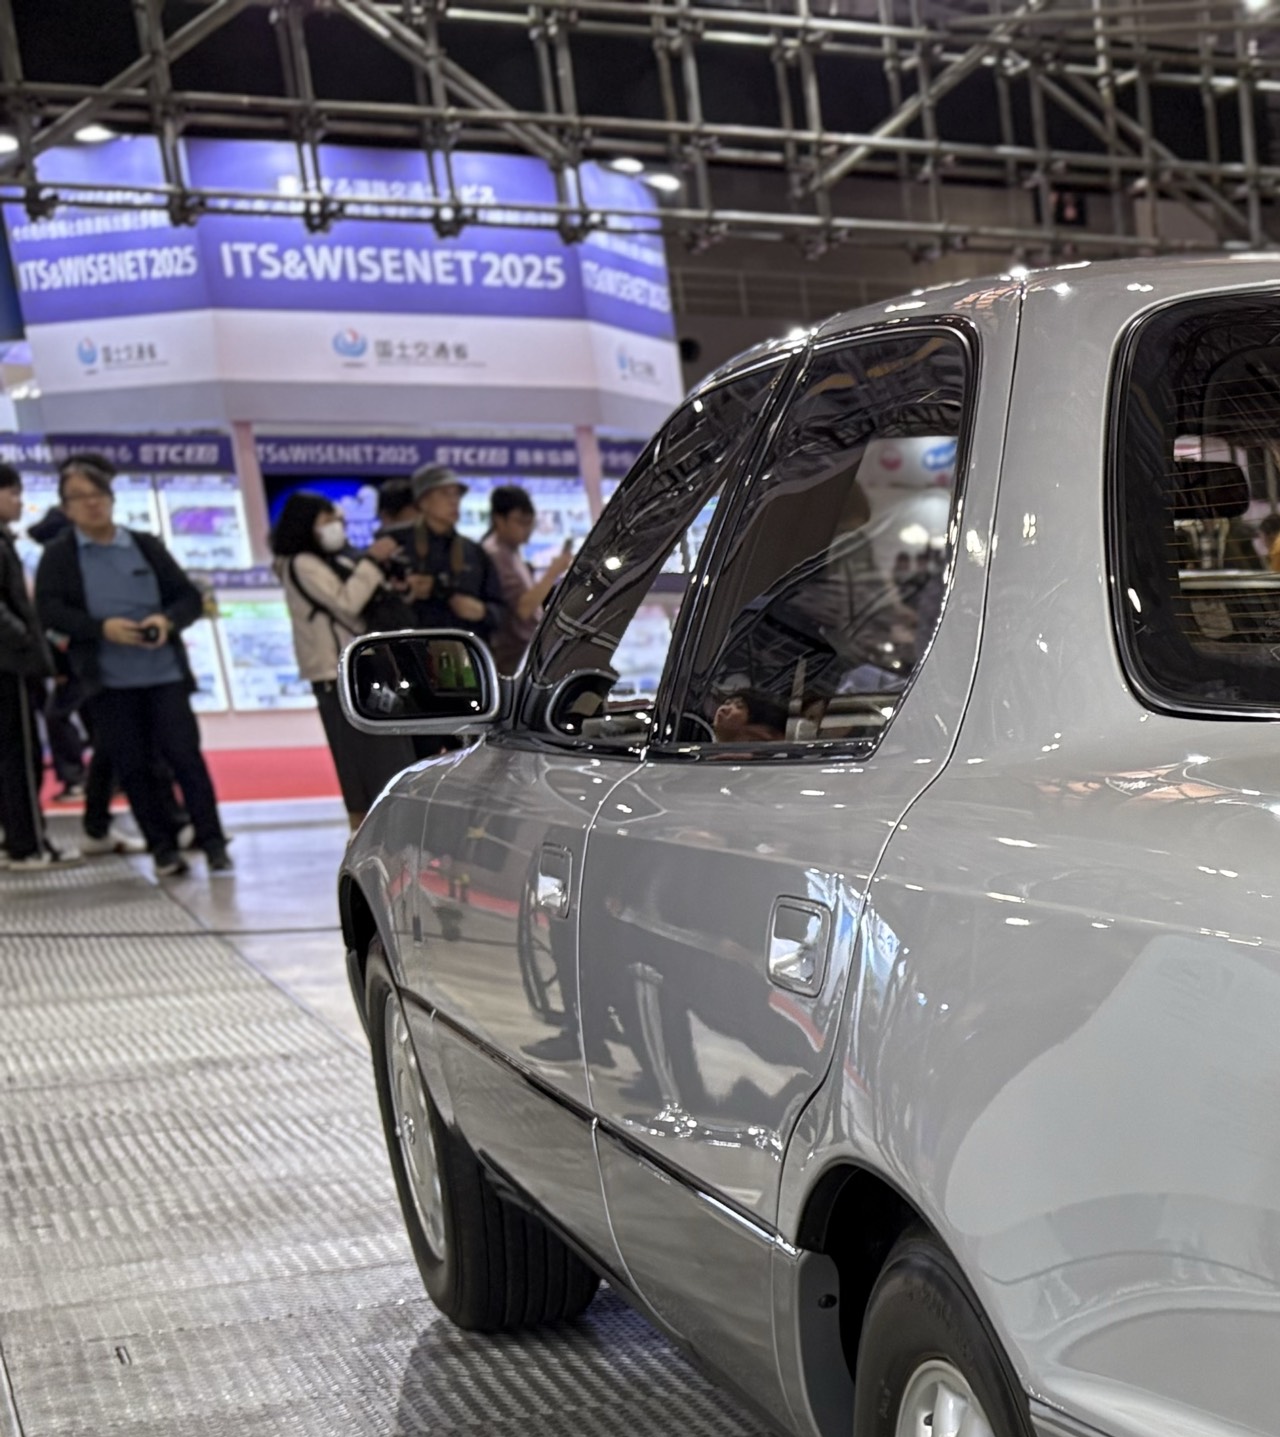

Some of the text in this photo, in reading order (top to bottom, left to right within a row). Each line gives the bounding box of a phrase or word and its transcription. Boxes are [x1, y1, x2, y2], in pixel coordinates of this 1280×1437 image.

[18, 245, 199, 292] ITS&WISENET2025
[220, 242, 566, 290] ITS&WISENET2025
[254, 443, 420, 465] TS&WISENET2025
